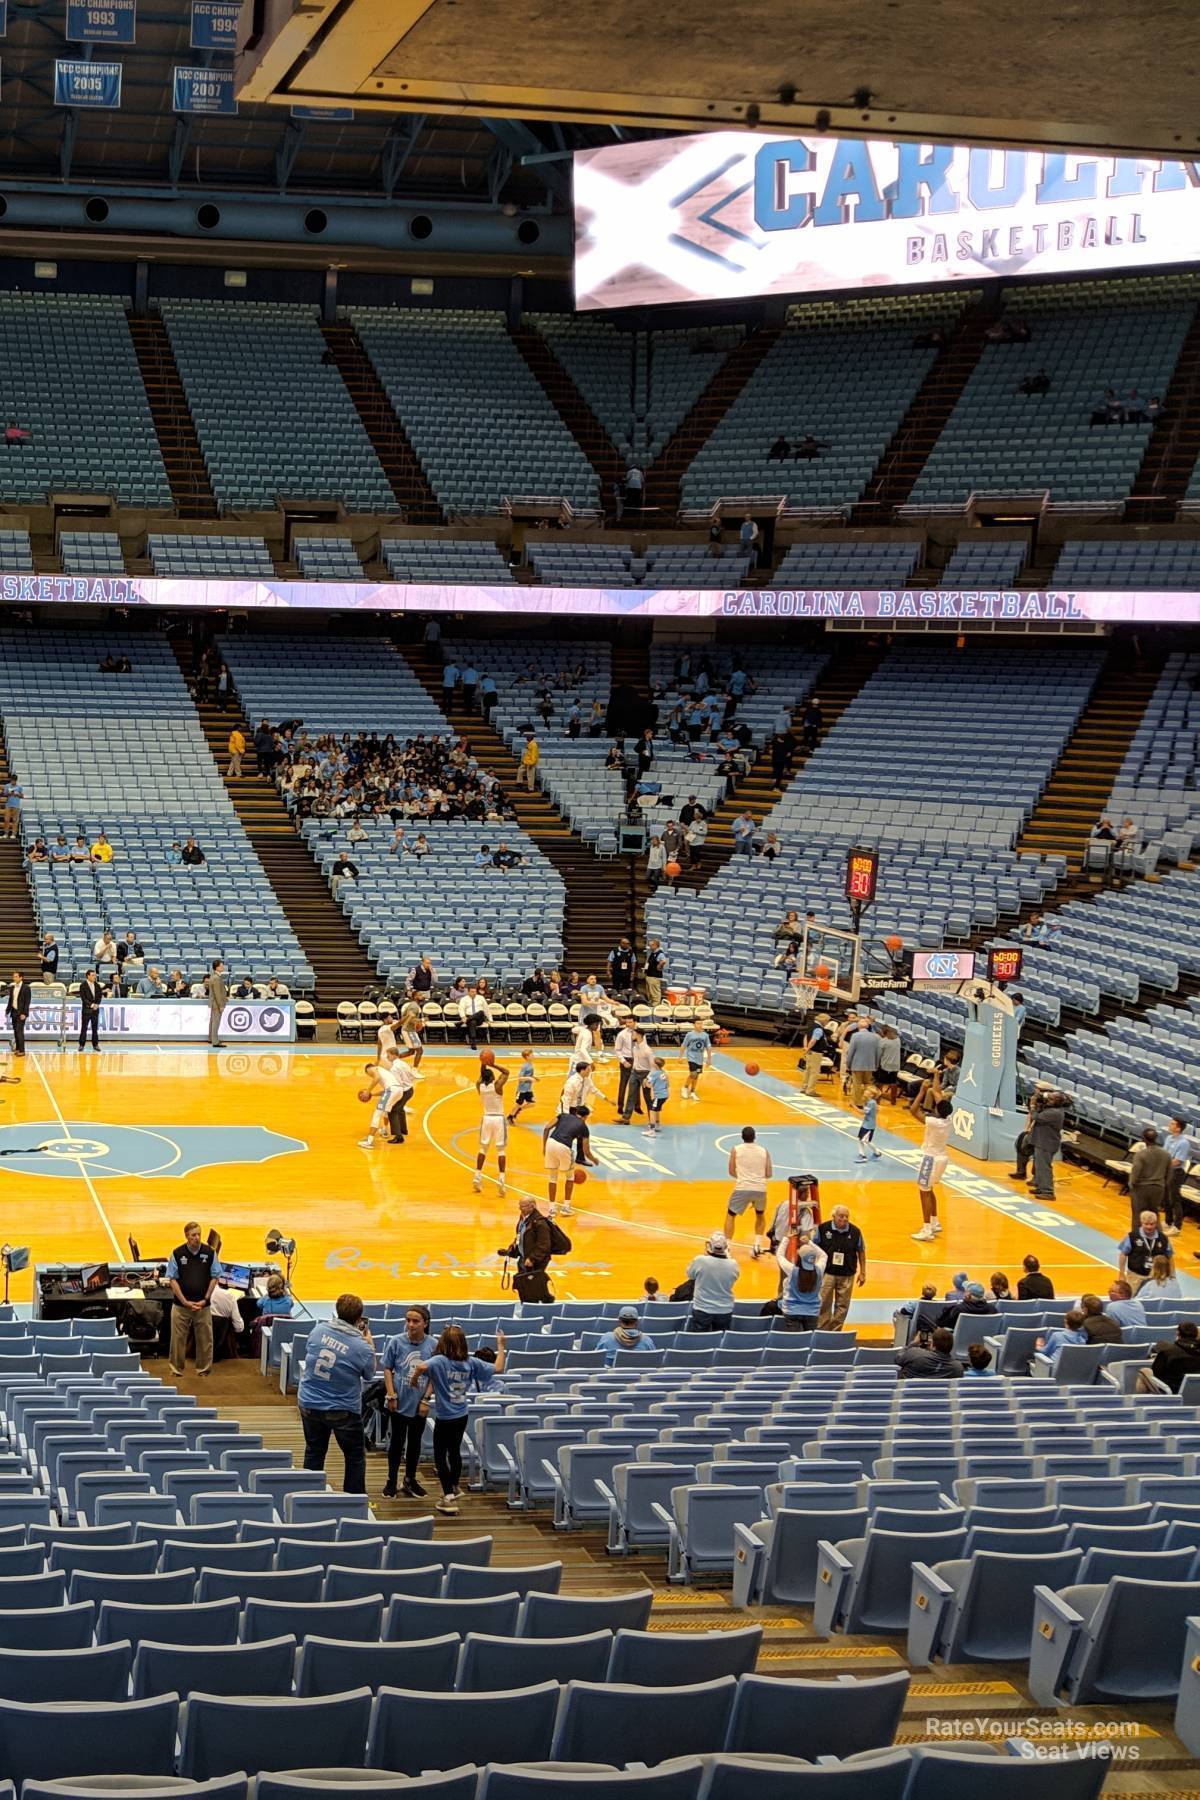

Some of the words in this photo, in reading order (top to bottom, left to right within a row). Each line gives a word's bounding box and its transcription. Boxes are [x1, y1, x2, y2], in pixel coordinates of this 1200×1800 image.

[194, 4, 210, 15] ACC
[87, 11, 115, 25] 1993
[59, 63, 74, 74] ACC
[75, 64, 119, 75] CHAMPIONS
[177, 70, 192, 80] ACC
[73, 77, 102, 90] 2005
[192, 83, 221, 96] 2007
[906, 213, 1147, 266] BASKETBALL
[722, 592, 864, 616] CAROLINA
[877, 592, 1082, 619] BASKETBALL
[321, 1334, 350, 1354] WHITE
[314, 1348, 337, 1382] 2
